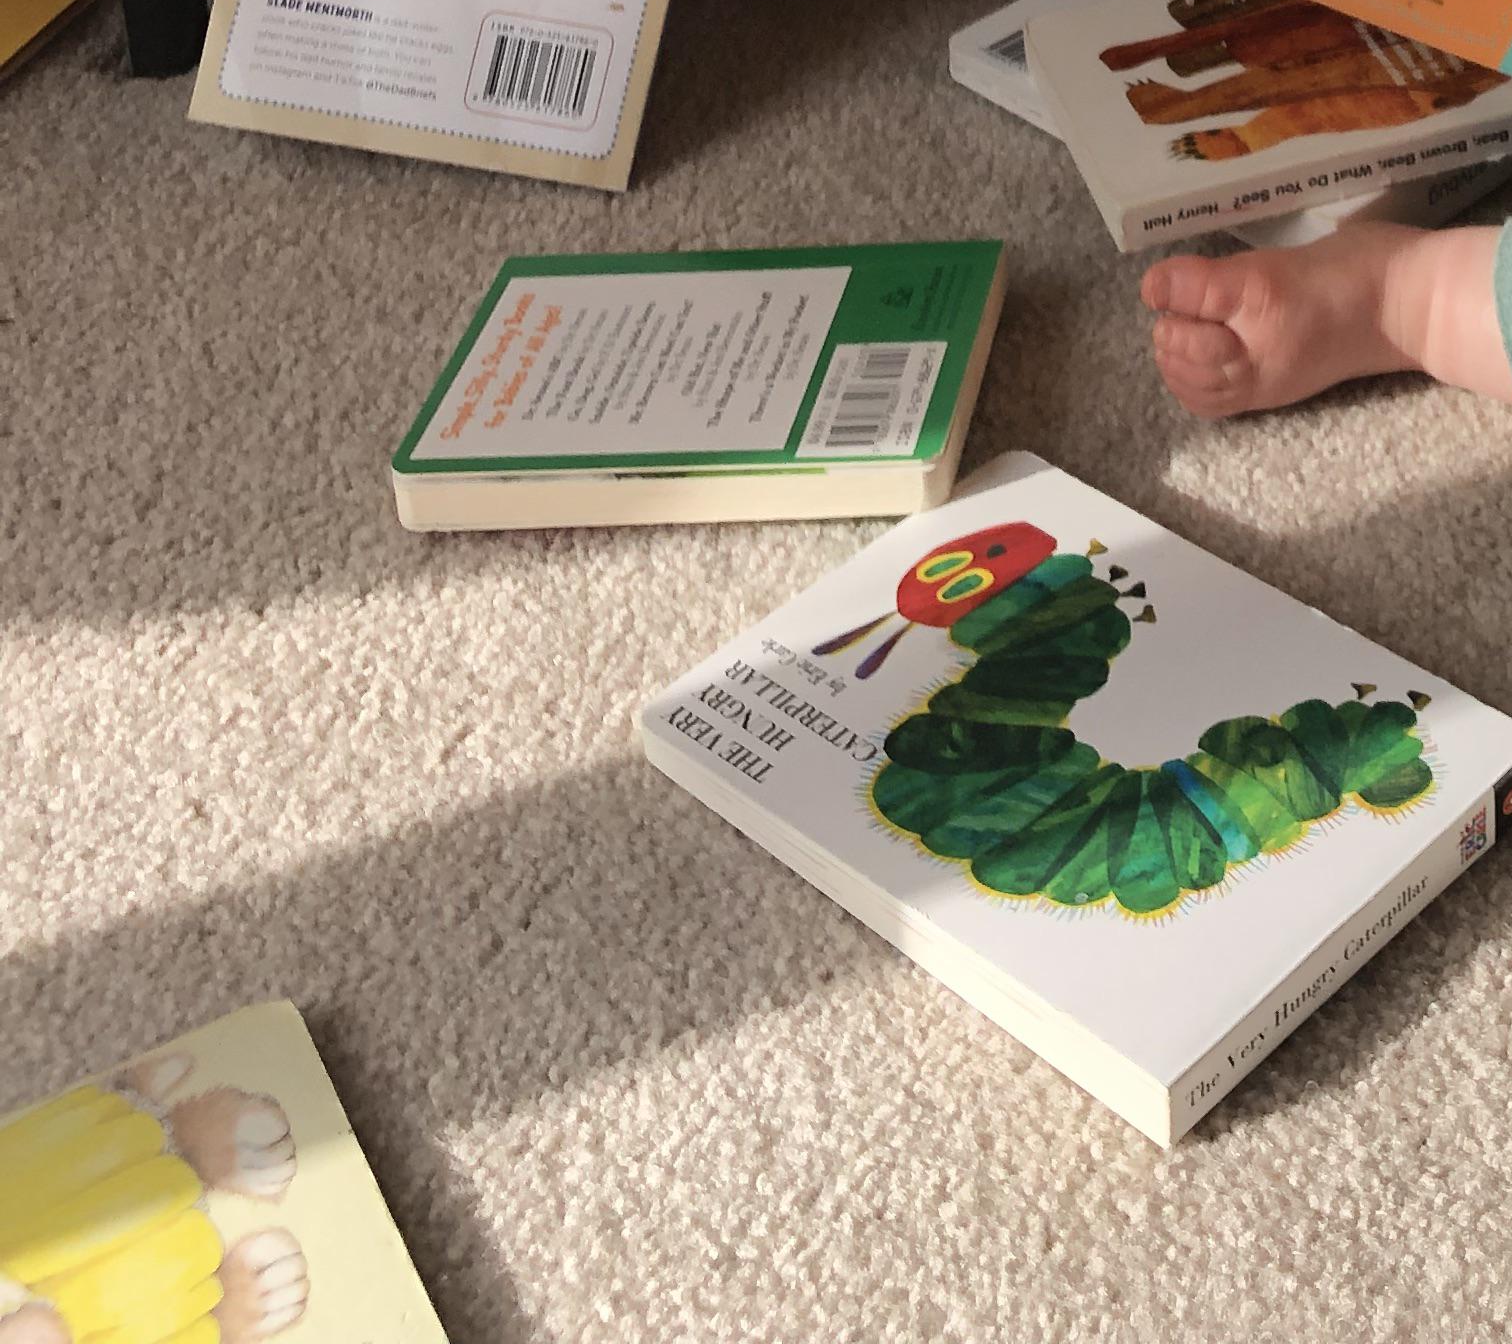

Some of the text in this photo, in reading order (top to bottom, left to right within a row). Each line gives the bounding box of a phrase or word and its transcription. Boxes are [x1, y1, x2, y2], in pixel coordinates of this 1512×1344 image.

[1417, 136, 1469, 162] Brown
[1470, 125, 1511, 150] Bear,
[1331, 162, 1373, 184] What
[1376, 148, 1417, 173] Bear,
[1273, 178, 1303, 199] You
[1305, 172, 1330, 191] Do
[1230, 186, 1272, 209] See?
[1140, 197, 1221, 232] Henry Holt
[692, 683, 796, 752] HUNGRY
[725, 659, 879, 762] CATERPILLAR
[659, 706, 775, 784] THE VERY
[1184, 873, 1430, 1110] The Very Hungry Caterpillar
